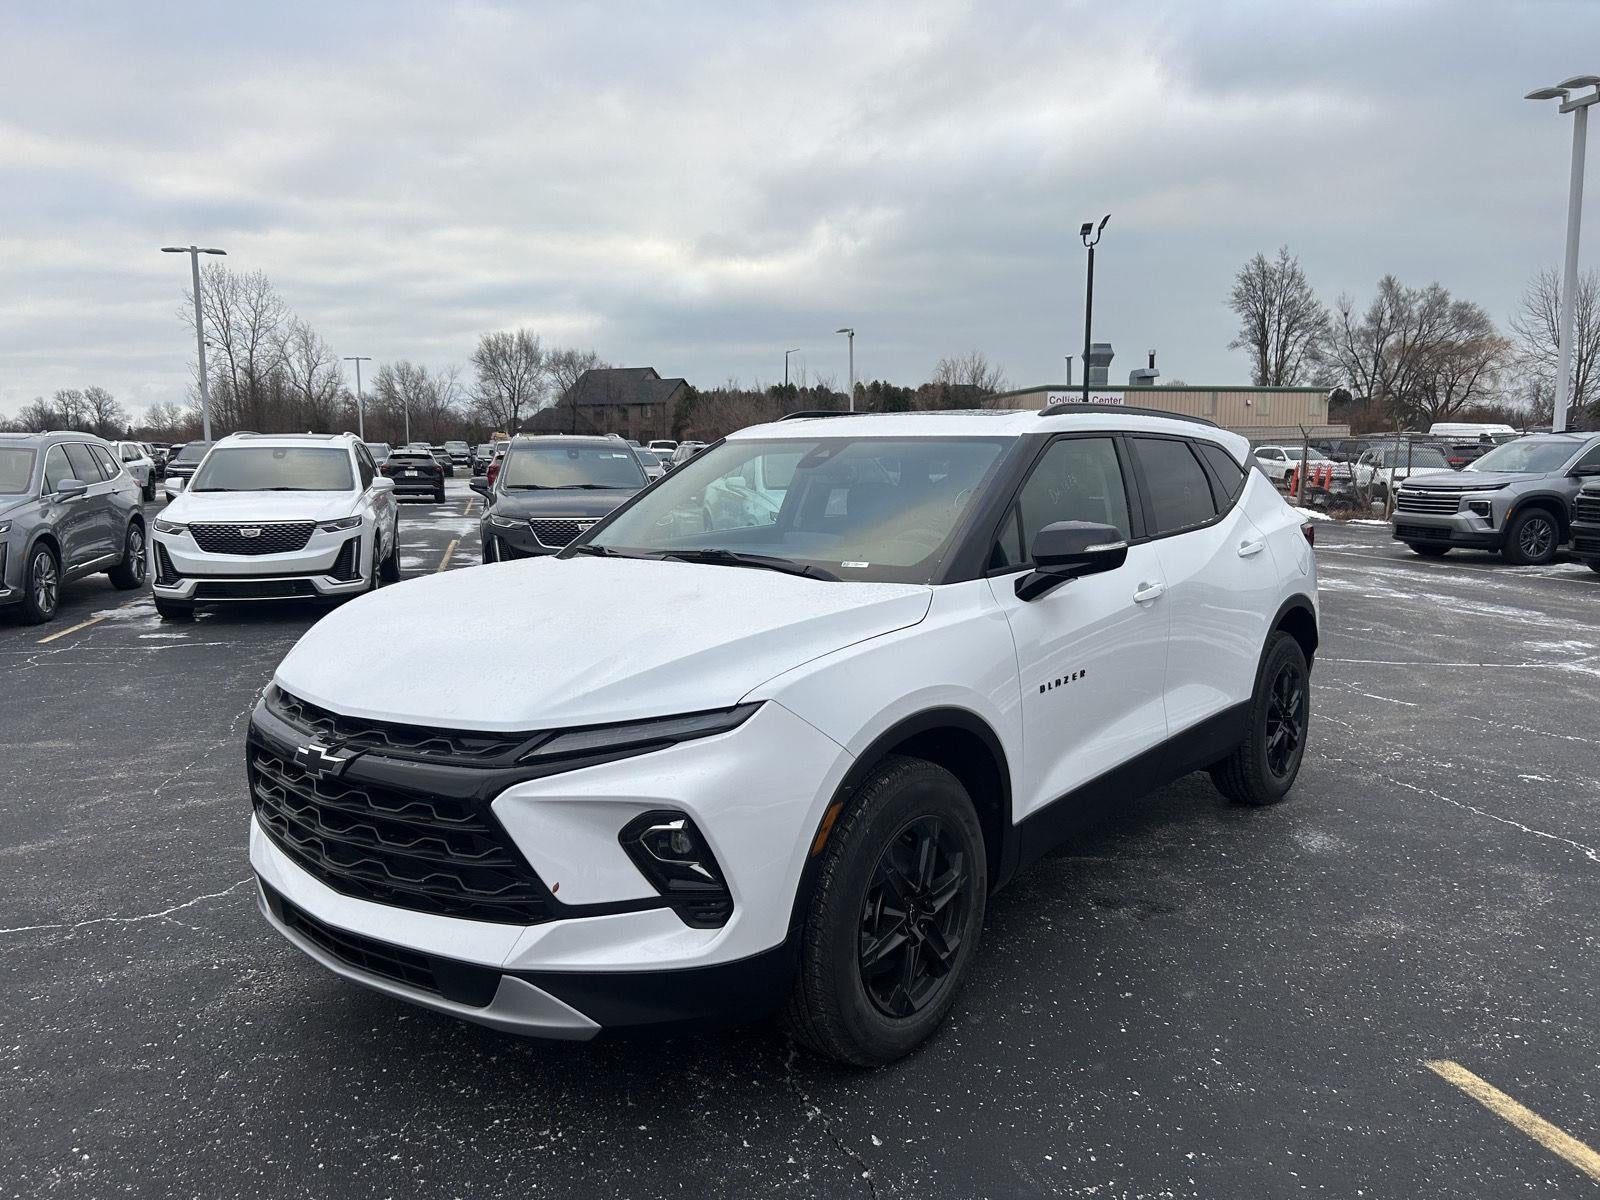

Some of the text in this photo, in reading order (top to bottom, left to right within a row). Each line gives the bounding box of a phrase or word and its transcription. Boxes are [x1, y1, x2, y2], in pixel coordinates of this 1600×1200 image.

[1049, 395, 1123, 405] Collisio Center
[1039, 669, 1086, 693] BLAZER
